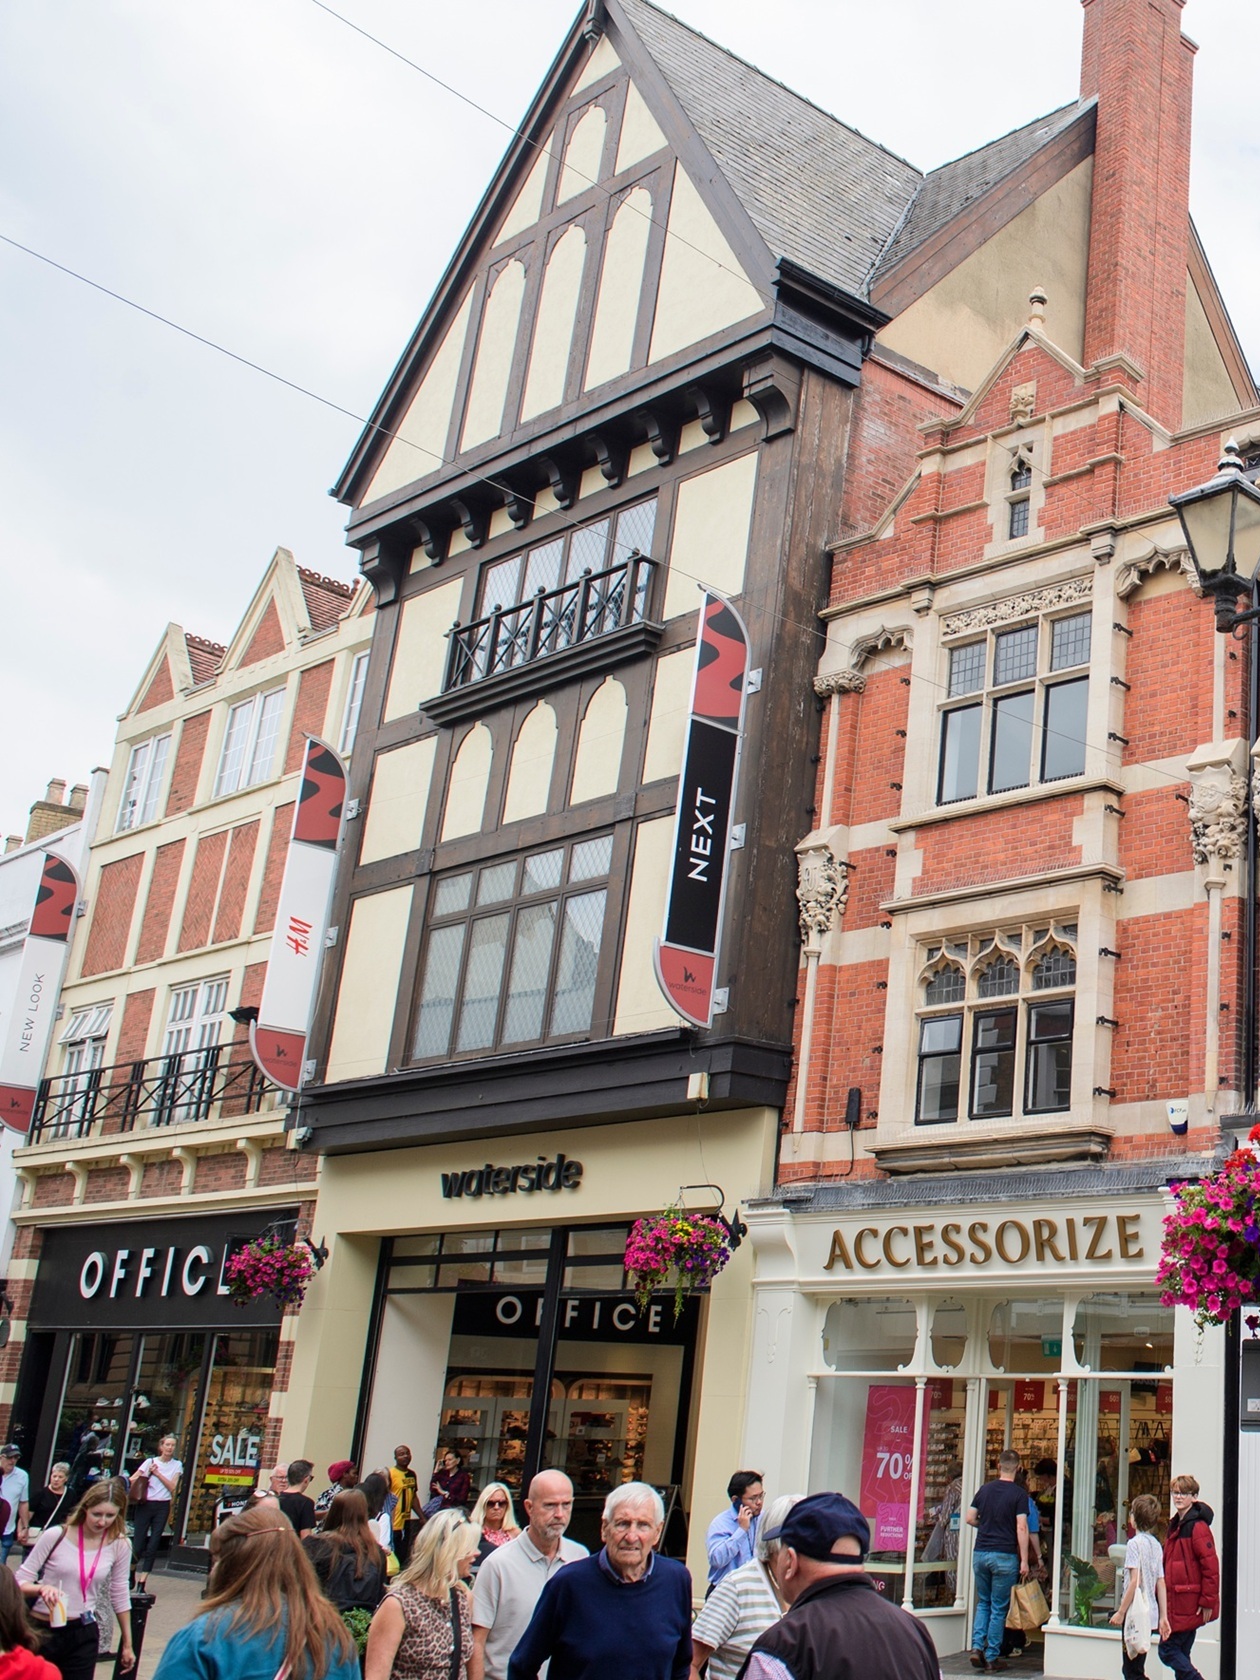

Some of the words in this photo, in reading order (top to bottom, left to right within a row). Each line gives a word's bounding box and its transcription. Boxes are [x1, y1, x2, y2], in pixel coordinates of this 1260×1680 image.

[687, 787, 717, 882] NEXT
[286, 916, 313, 957] H&M
[668, 980, 707, 996] waterside
[19, 1017, 35, 1052] NEW
[28, 973, 45, 1012] LOOK
[441, 1153, 583, 1199] waterside
[823, 1213, 1145, 1271] ACCESSORIZE
[890, 1425, 908, 1433] SALE
[209, 1434, 260, 1467] SALE
[903, 1472, 913, 1480] OF
